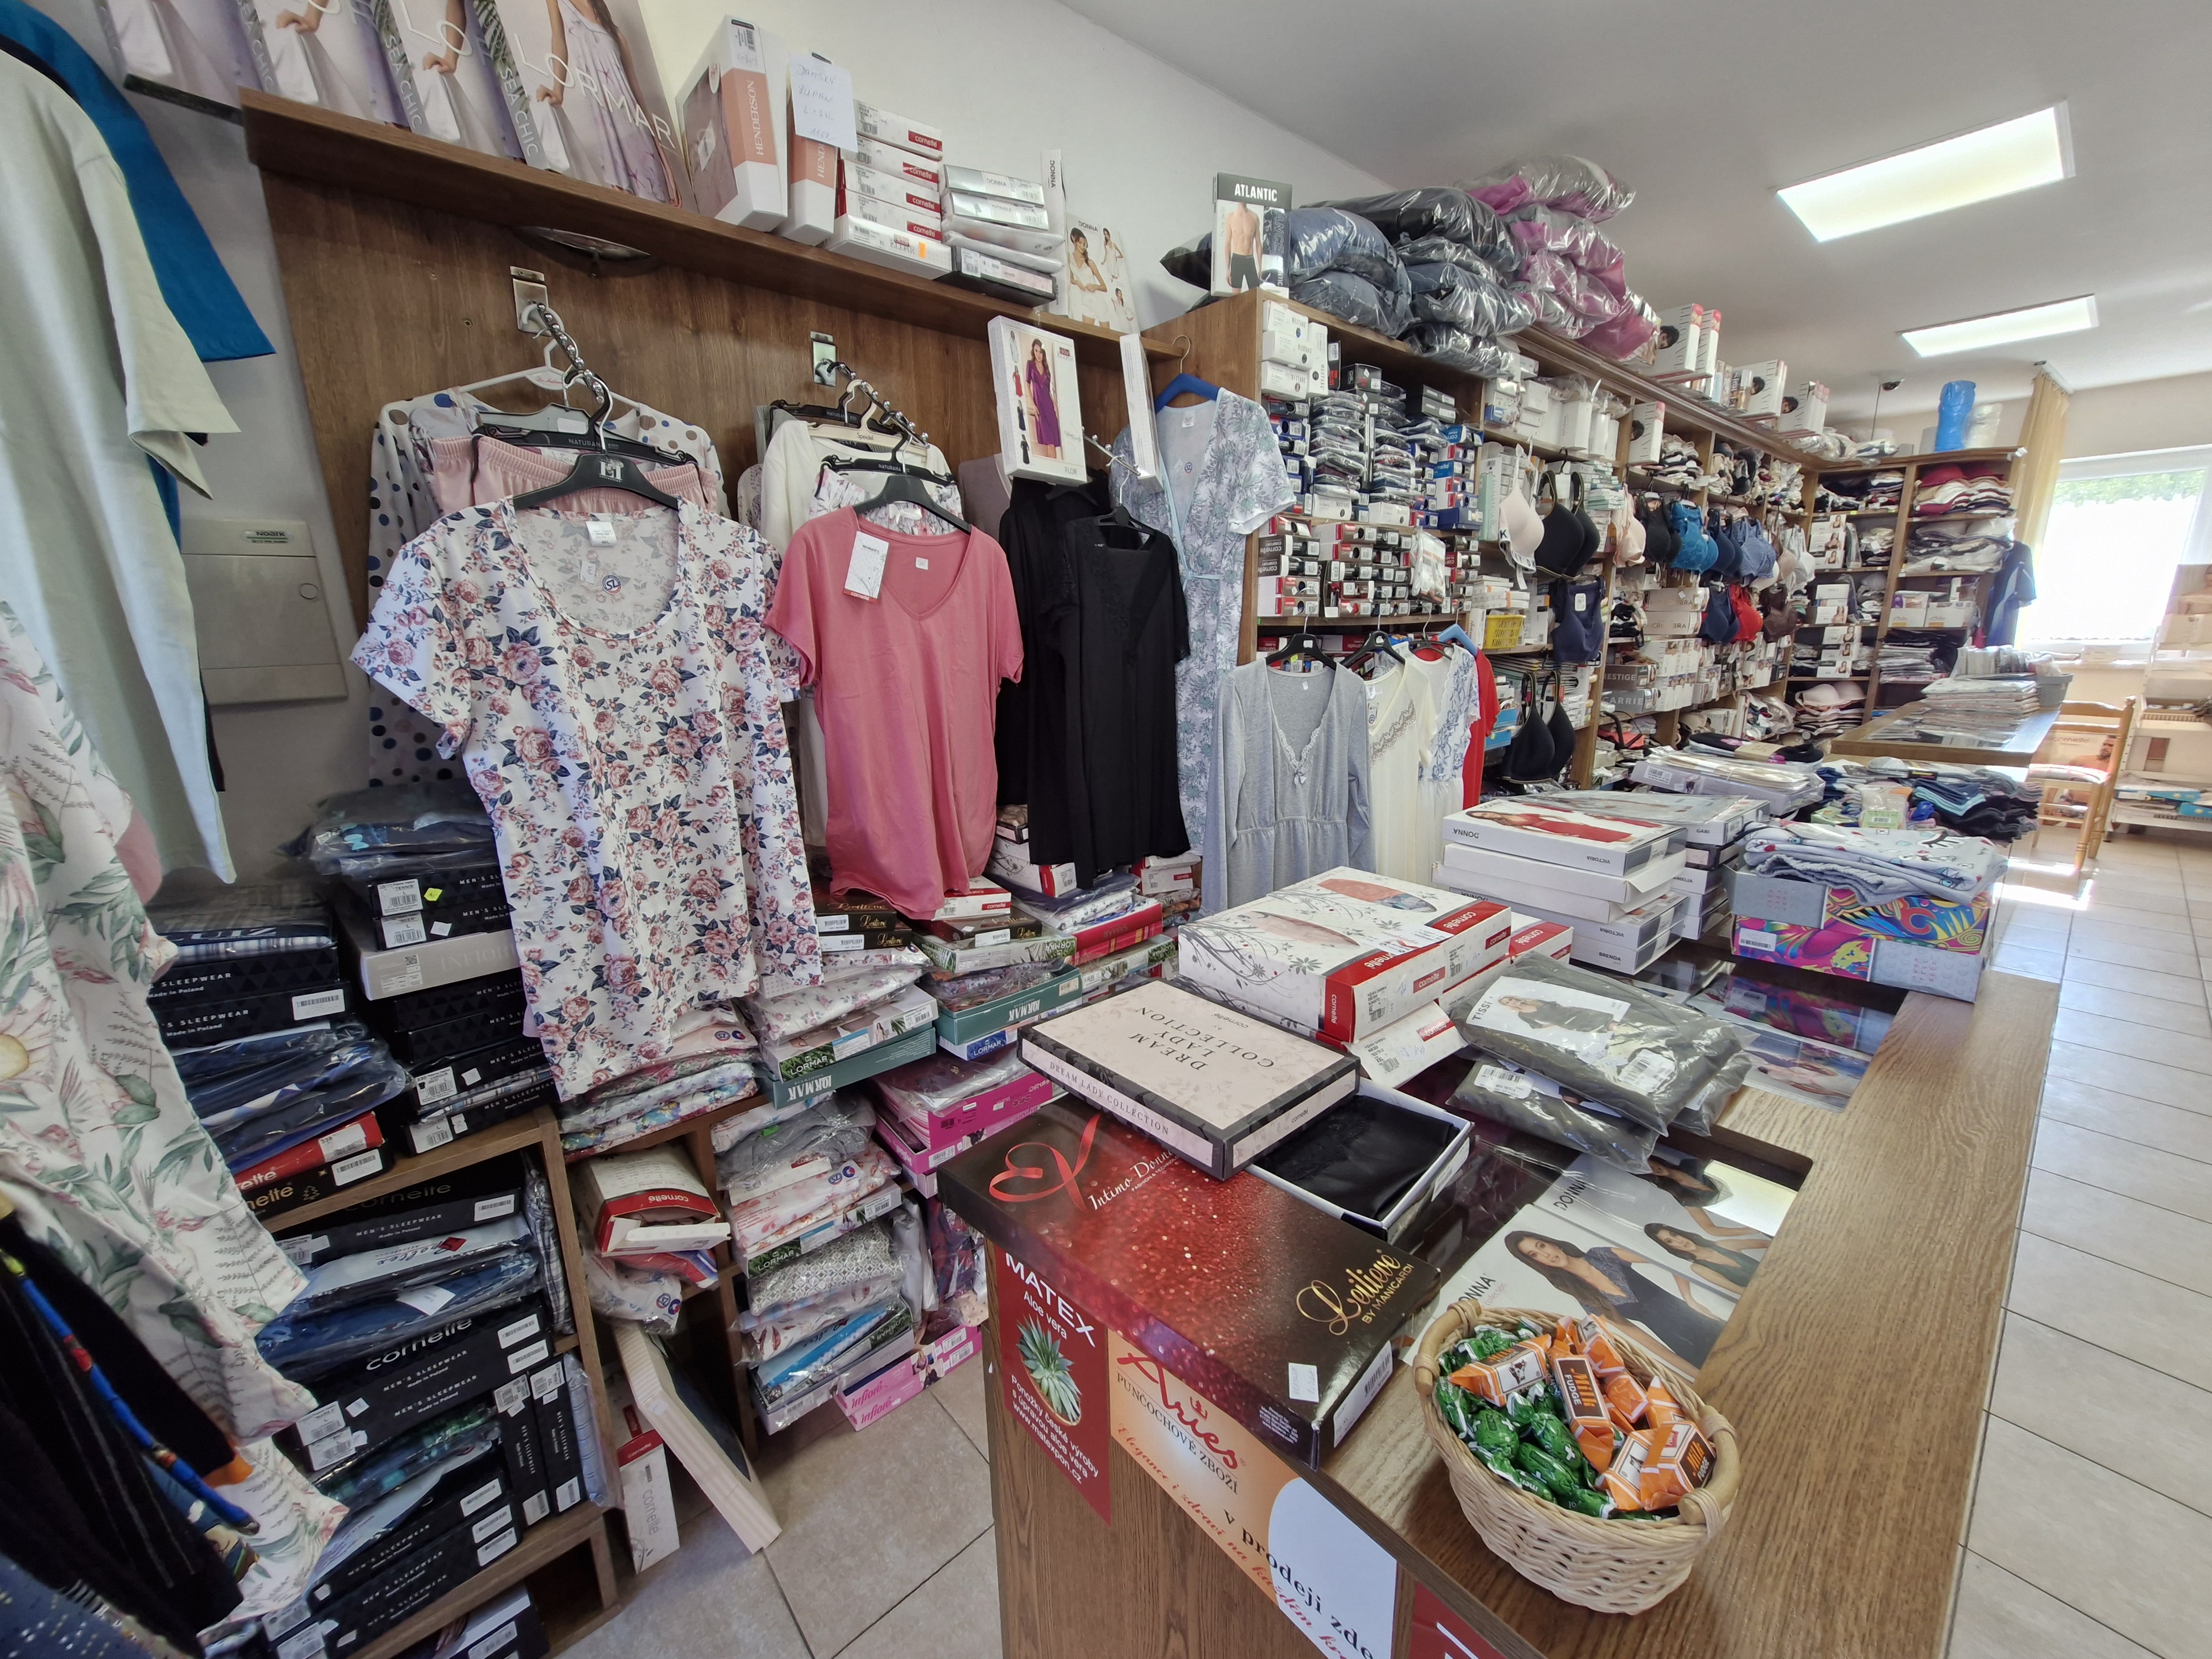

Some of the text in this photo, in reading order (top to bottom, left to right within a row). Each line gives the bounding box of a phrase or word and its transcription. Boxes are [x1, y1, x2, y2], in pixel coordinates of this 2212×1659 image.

[387, 34, 424, 129] SEA CHIC
[499, 67, 540, 158] SEA CHIC
[747, 80, 765, 155] HENDERSON
[1234, 183, 1278, 202] ATLANTIC
[1078, 220, 1098, 232] DONNA
[568, 437, 602, 447] NATURAN
[857, 432, 874, 441] Speidel
[878, 463, 901, 472] NATURANA
[1064, 467, 1078, 476] FLOR
[1602, 696, 1644, 705] CARRIE
[1452, 827, 1479, 839] DONNA
[1586, 855, 1611, 865] VICTORIA
[463, 907, 489, 916] MEN'S
[1599, 927, 1625, 938] VICTORIA
[1045, 940, 1076, 952] LORMAR
[1599, 951, 1621, 962] BRENDA
[161, 972, 232, 988] SLEEPWEAR
[178, 985, 205, 994] Poland
[180, 1009, 249, 1026] SLEEPWEAR
[196, 1023, 223, 1032] Poland
[973, 1038, 1002, 1056] LORMAR
[1134, 1005, 1275, 1068] COLLECTION
[1153, 1029, 1217, 1057] LADY
[518, 1044, 541, 1055] SLEEP
[1129, 1032, 1209, 1072] DREAM
[790, 1055, 828, 1076] LORMAR
[512, 1081, 555, 1099] SLEEPWEA
[1050, 1061, 1170, 1136] DREAM LADY COLLECTION
[1290, 1108, 1310, 1124] cornette
[1129, 1150, 1173, 1179] Donn
[1131, 1175, 1152, 1192] FASHION
[1552, 1178, 1587, 1212] DONNA
[648, 1193, 690, 1203] cornette
[389, 1213, 442, 1229] SLEEPWEAR
[758, 1249, 795, 1271] LORMAR
[1004, 1251, 1097, 1348] MATEX
[1361, 1263, 1415, 1324] BY MANICARDI
[1023, 1290, 1068, 1340] Aloe vera
[365, 1318, 472, 1371] cornette
[415, 1350, 467, 1377] SLEEPWEAR
[426, 1375, 477, 1402] SLEEPWEAR
[1563, 1373, 1582, 1406] FUDGE
[1569, 1367, 1598, 1408] Milk
[1117, 1352, 1239, 1471] Aries
[1010, 1374, 1099, 1479] Ponožky české výroby
[1018, 1391, 1048, 1434] úpravou
[1048, 1428, 1068, 1452] aloe
[1068, 1452, 1089, 1479] vera
[1115, 1371, 1198, 1454] PUNČOCHOVÉ
[1199, 1447, 1239, 1495] ZBOŽÍ
[1011, 1400, 1083, 1485] www.matexpon.cz
[1686, 1439, 1705, 1478] Milk
[1697, 1455, 1710, 1483] FUDGE
[1117, 1422, 1169, 1484] Elegance
[1180, 1492, 1227, 1538] zdraví
[1226, 1541, 1249, 1562] na
[1251, 1564, 1314, 1629] každém
[1223, 1507, 1237, 1526] v
[1241, 1527, 1323, 1616] prodeji
